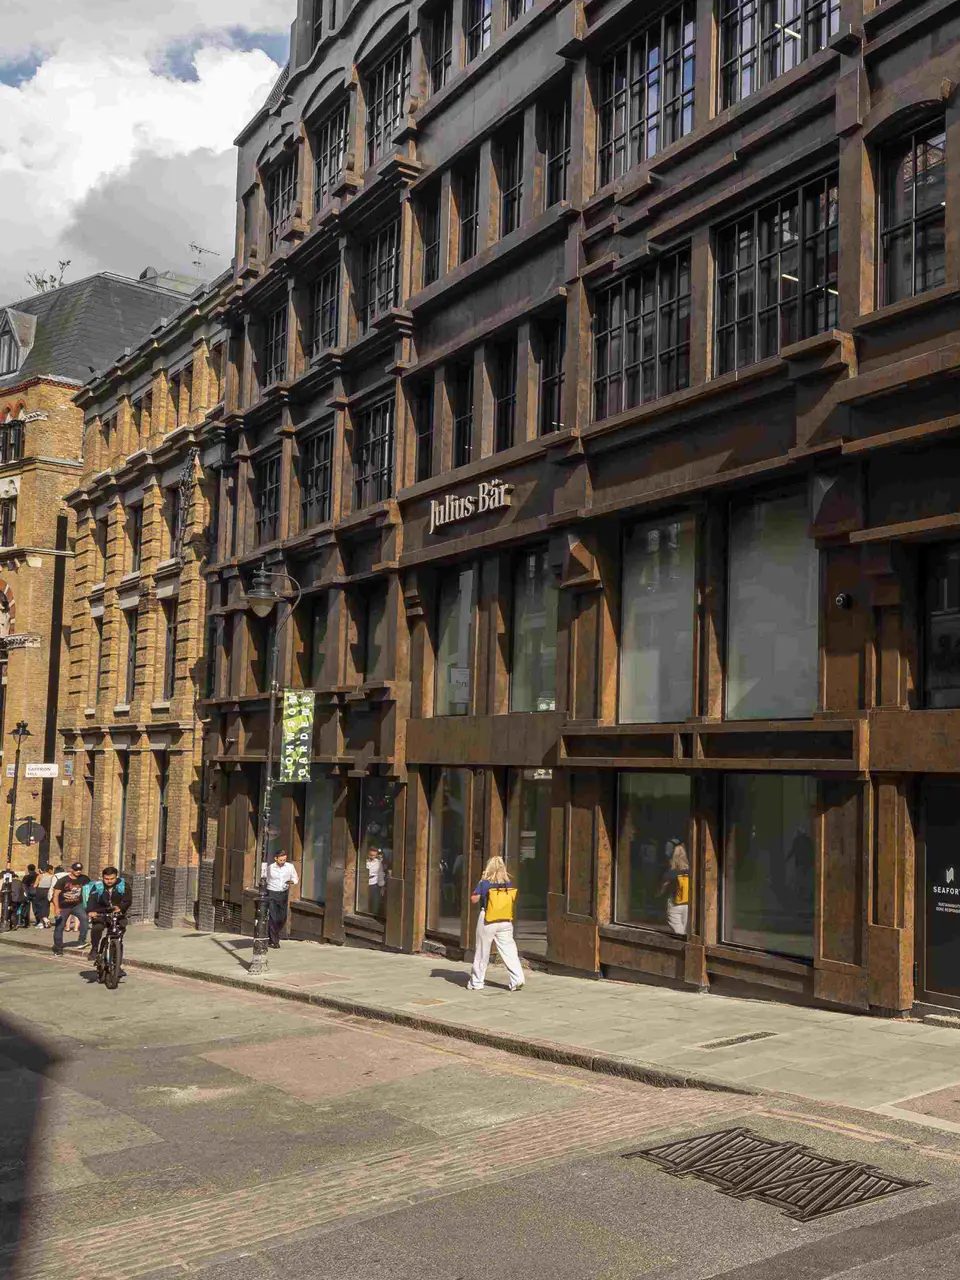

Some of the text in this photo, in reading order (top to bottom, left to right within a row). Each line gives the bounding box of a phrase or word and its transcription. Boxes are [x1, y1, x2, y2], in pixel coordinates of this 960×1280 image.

[429, 478, 511, 535] Julius Bär
[284, 695, 298, 776] JOHNSON
[298, 695, 311, 776] GARDENS
